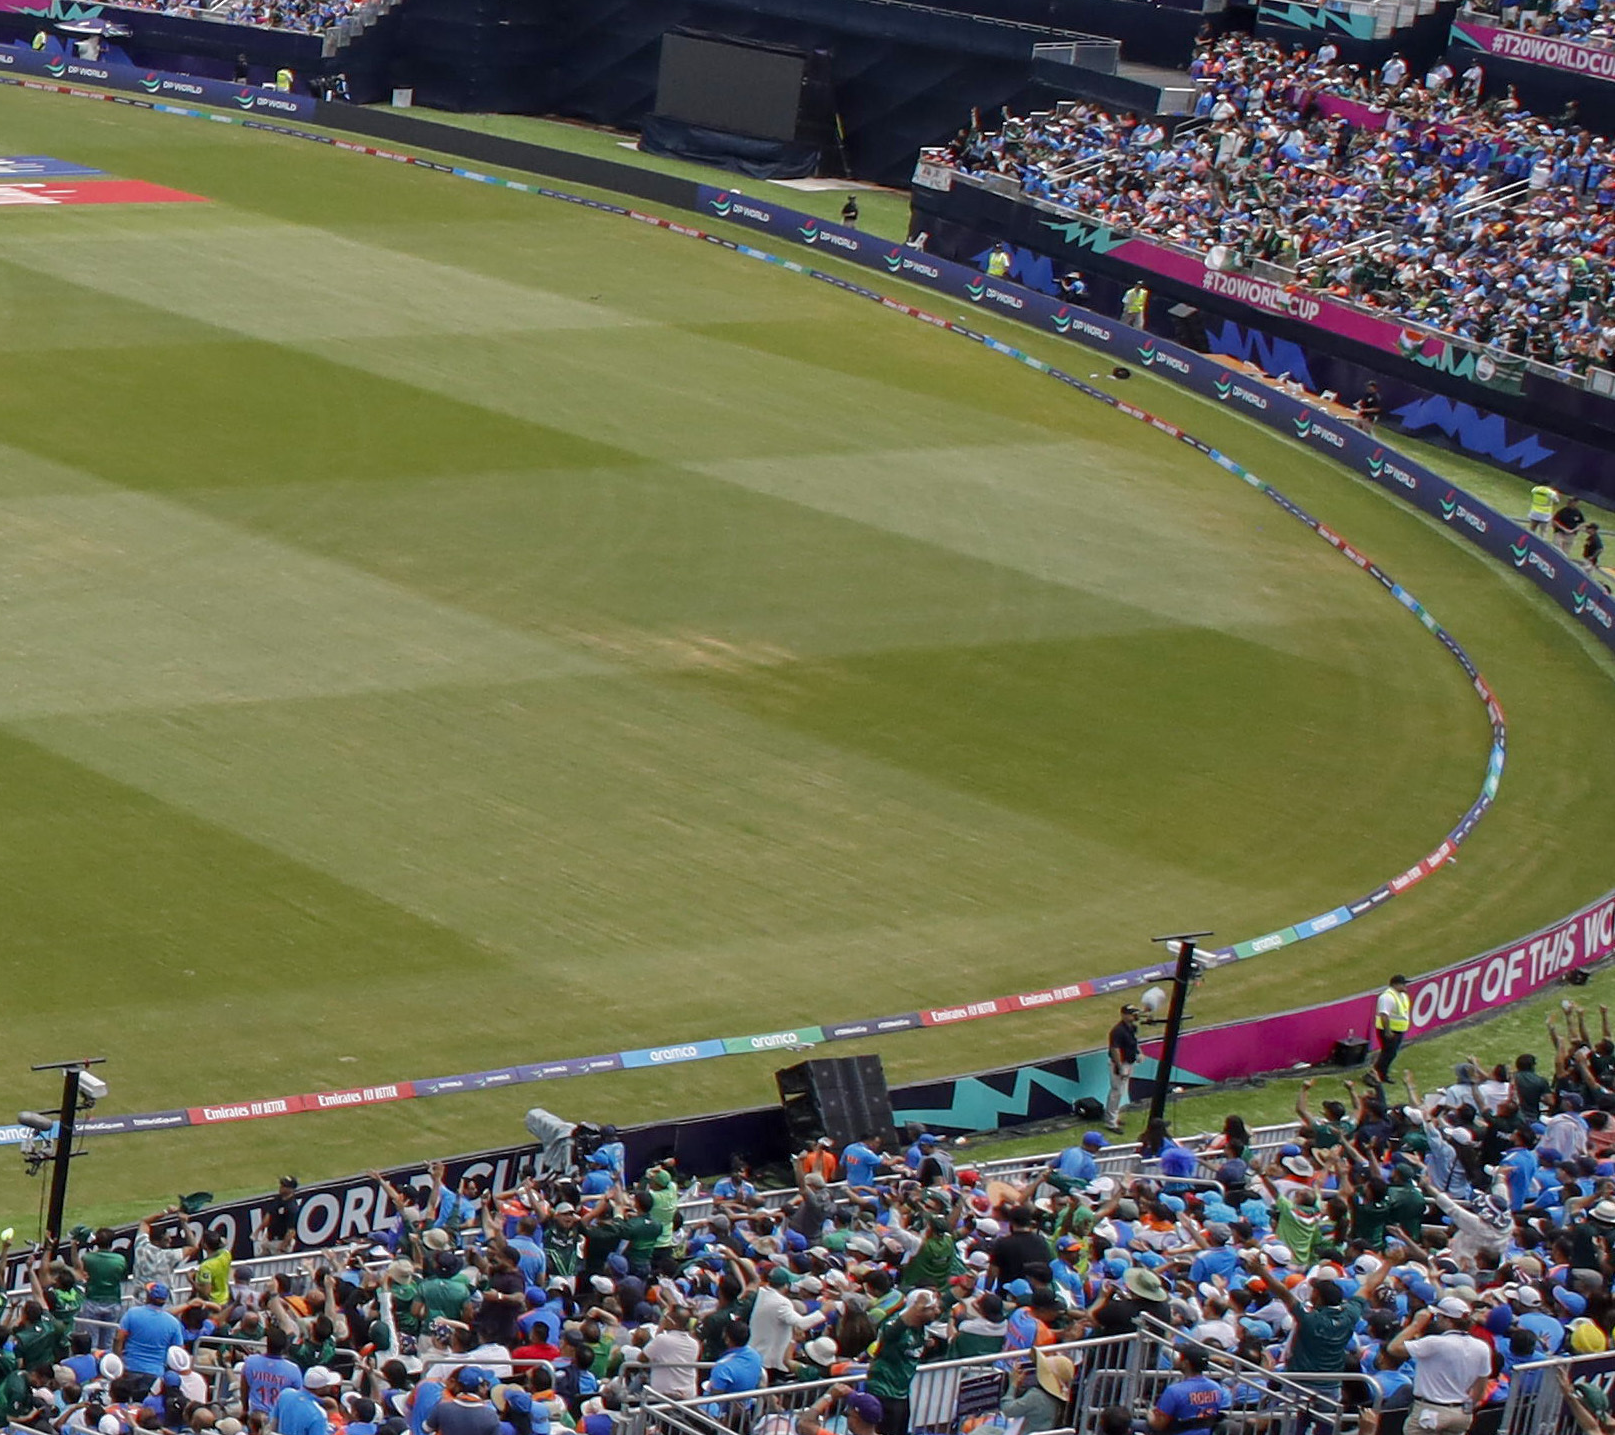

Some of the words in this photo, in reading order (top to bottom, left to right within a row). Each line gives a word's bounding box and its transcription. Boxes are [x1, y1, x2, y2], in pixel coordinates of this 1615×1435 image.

[733, 204, 743, 215] DP
[744, 207, 769, 222] WORLD
[986, 286, 997, 299] DP
[997, 290, 1023, 309] WORLD
[1202, 270, 1320, 322] #T20WORLCUP
[1411, 966, 1479, 1026] OUT
[1481, 950, 1525, 1002] OF
[1528, 923, 1577, 985] THIS
[750, 1031, 797, 1049] aramco
[649, 1044, 697, 1062] aramco
[203, 1105, 249, 1120] Emirates
[251, 1101, 263, 1115] FLY
[264, 1099, 287, 1113] BETTER
